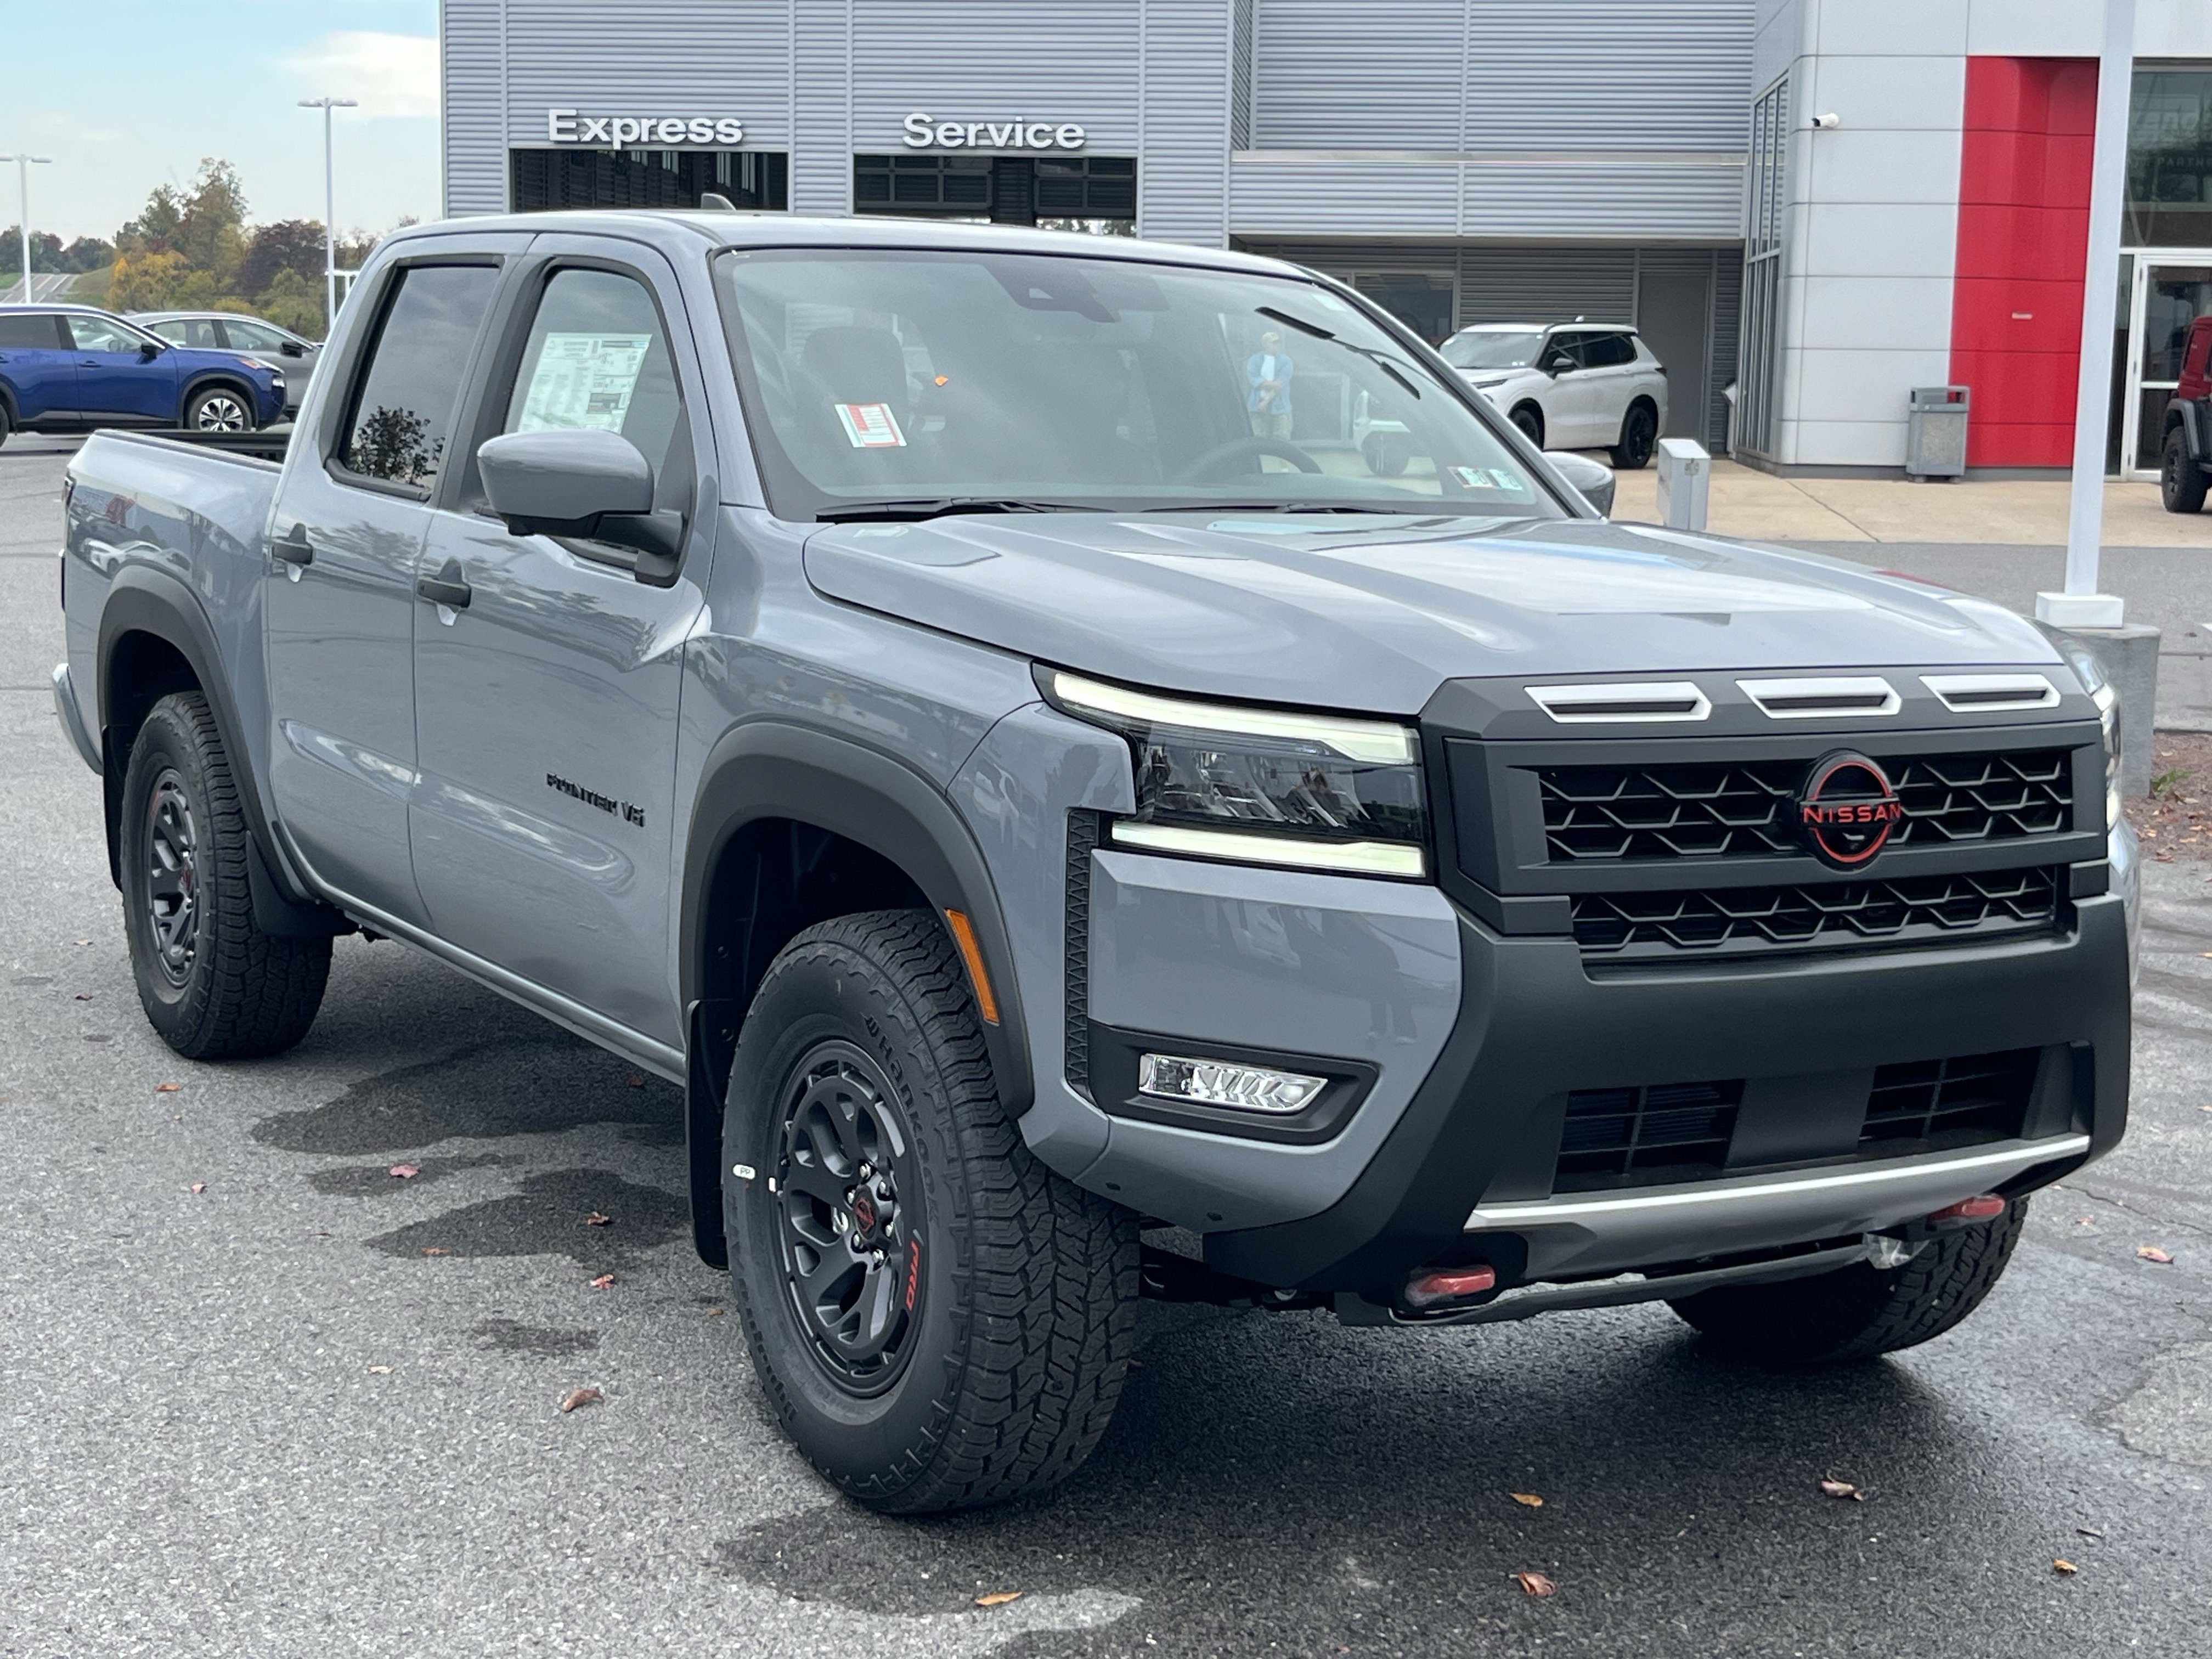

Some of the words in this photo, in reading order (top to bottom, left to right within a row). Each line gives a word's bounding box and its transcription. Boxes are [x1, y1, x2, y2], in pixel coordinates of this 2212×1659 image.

[549, 109, 743, 150] Express
[902, 113, 1086, 149] Service
[621, 800, 645, 828] V6
[1803, 803, 1901, 823] NISSAN
